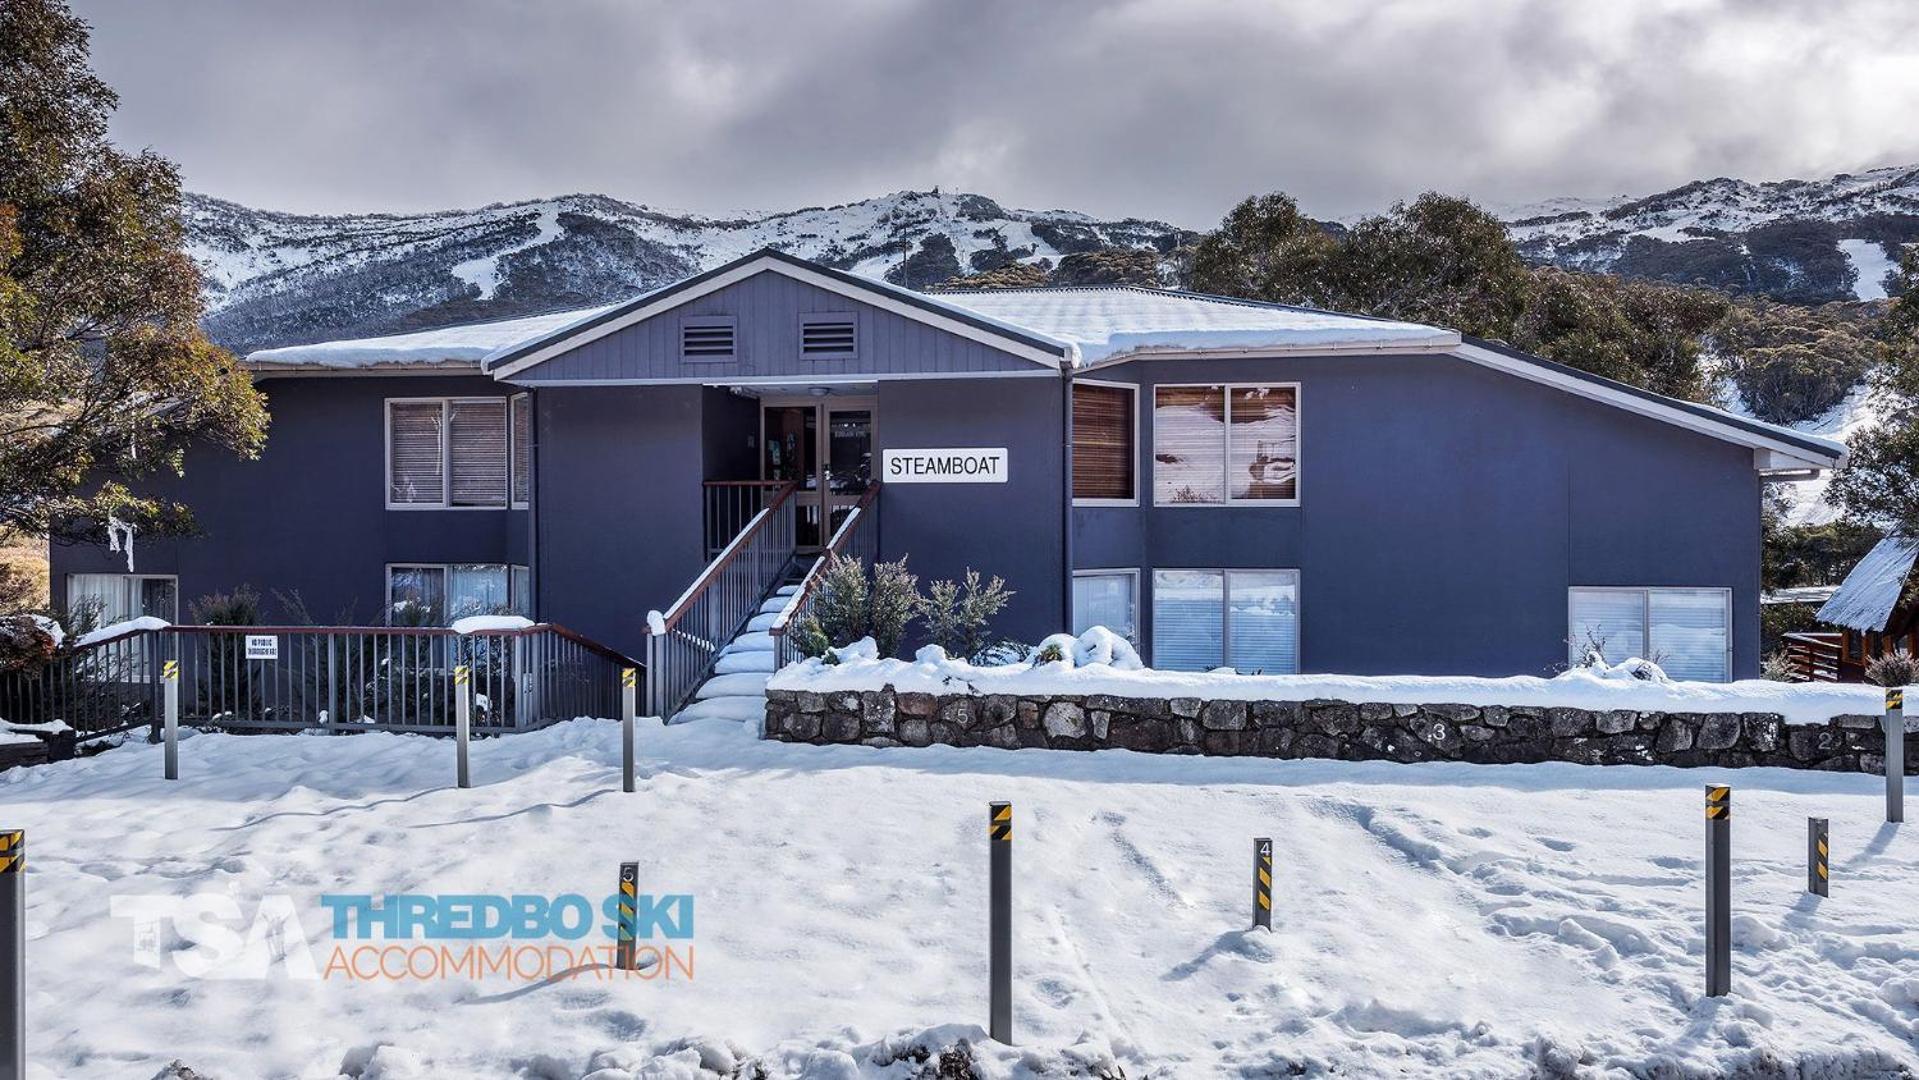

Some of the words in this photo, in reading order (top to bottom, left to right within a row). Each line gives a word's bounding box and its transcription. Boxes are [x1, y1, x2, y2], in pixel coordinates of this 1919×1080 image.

[890, 456, 1000, 475] STEAMBOAT
[957, 708, 968, 724] 5
[1432, 723, 1446, 740] 3
[1818, 732, 1832, 750] 2
[1260, 842, 1271, 856] 4
